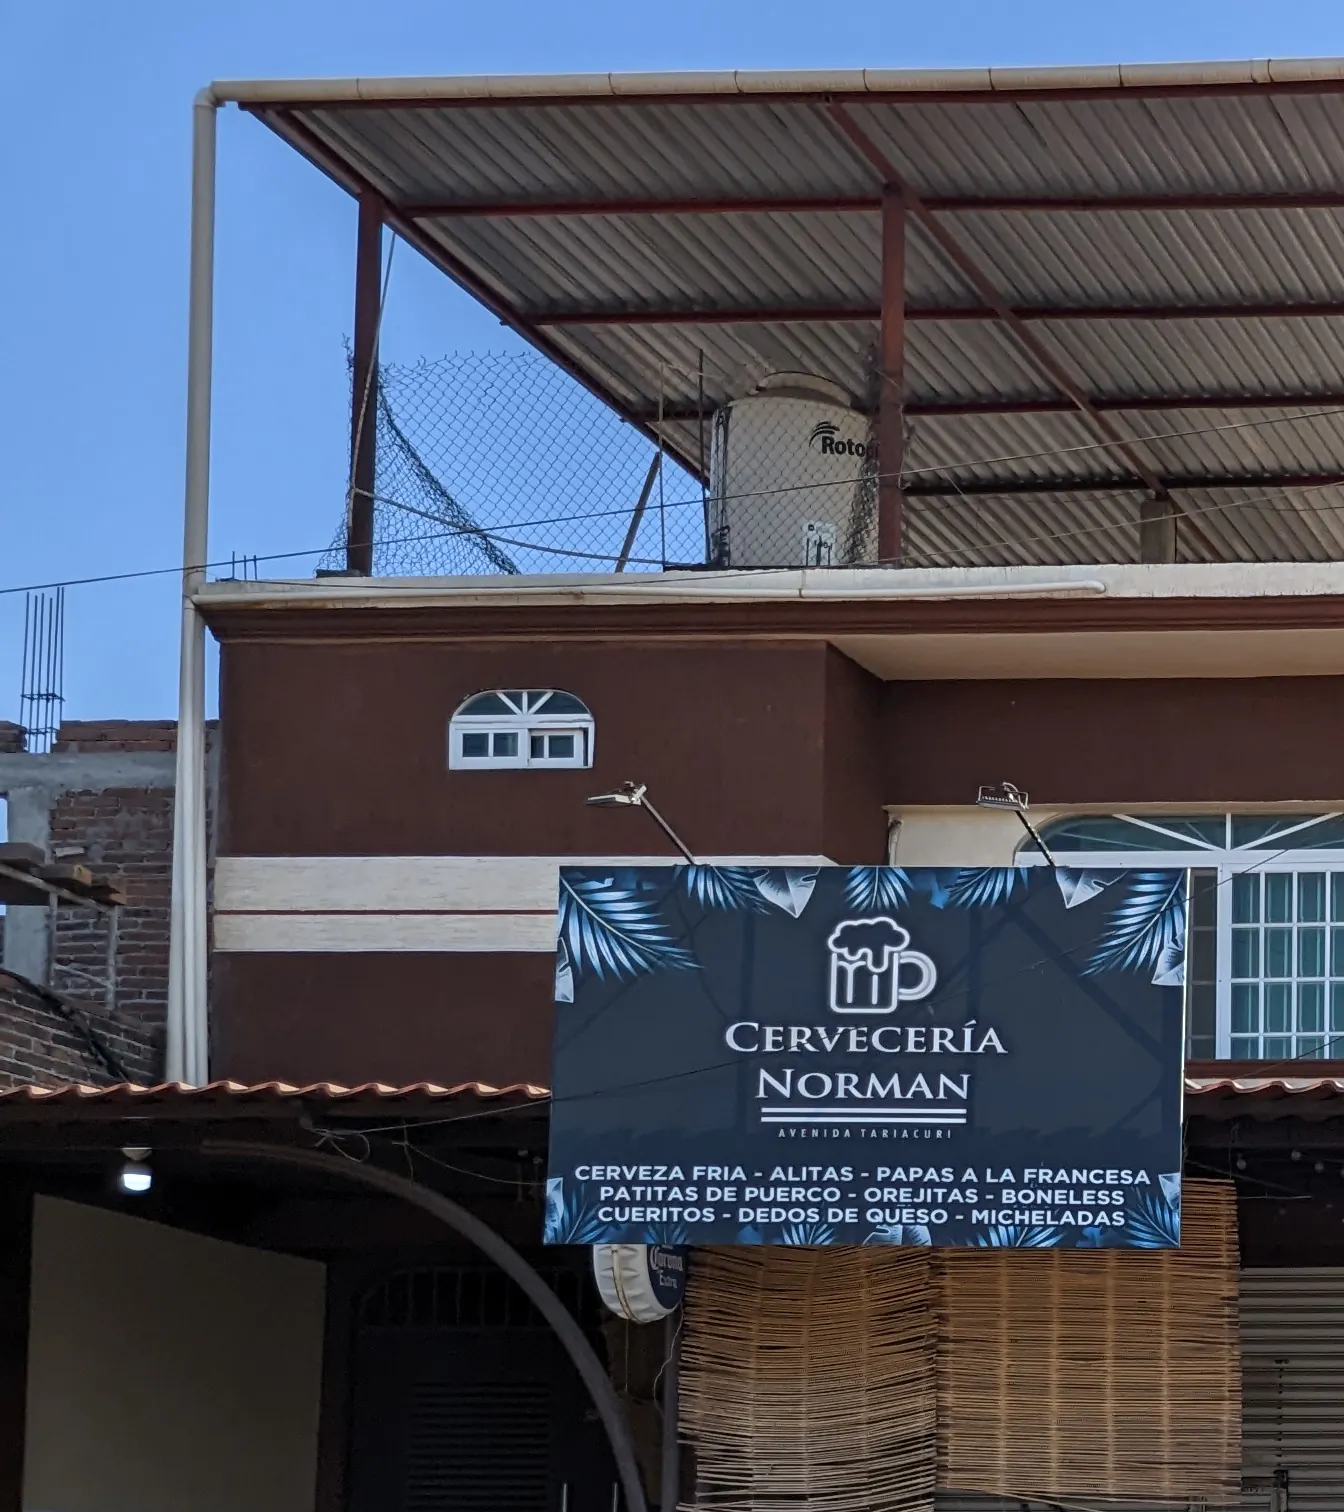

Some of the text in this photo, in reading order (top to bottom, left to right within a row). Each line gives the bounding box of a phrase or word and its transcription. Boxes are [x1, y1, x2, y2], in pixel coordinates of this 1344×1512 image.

[778, 1128, 952, 1140] AVENIDA TARIACURI
[575, 1165, 686, 1181] CERVEZA
[693, 1166, 747, 1181] FRIA
[769, 1166, 854, 1182] ALITAS
[877, 1167, 955, 1182] PAPAS
[961, 1167, 979, 1183] A
[986, 1168, 1016, 1183] LA
[1024, 1169, 1151, 1185] FRANCESA
[600, 1186, 698, 1202] PATITAS
[706, 1187, 737, 1202] DE
[745, 1187, 841, 1202] PUERCO
[864, 1188, 978, 1203] OREJITAS
[1002, 1189, 1125, 1205] BONELESS
[598, 1207, 715, 1222] CUERITOS
[739, 1208, 820, 1223] DEDOS
[828, 1208, 858, 1223] DE
[866, 1209, 948, 1225] QUESO
[971, 1210, 1125, 1226] MICHELADAS
